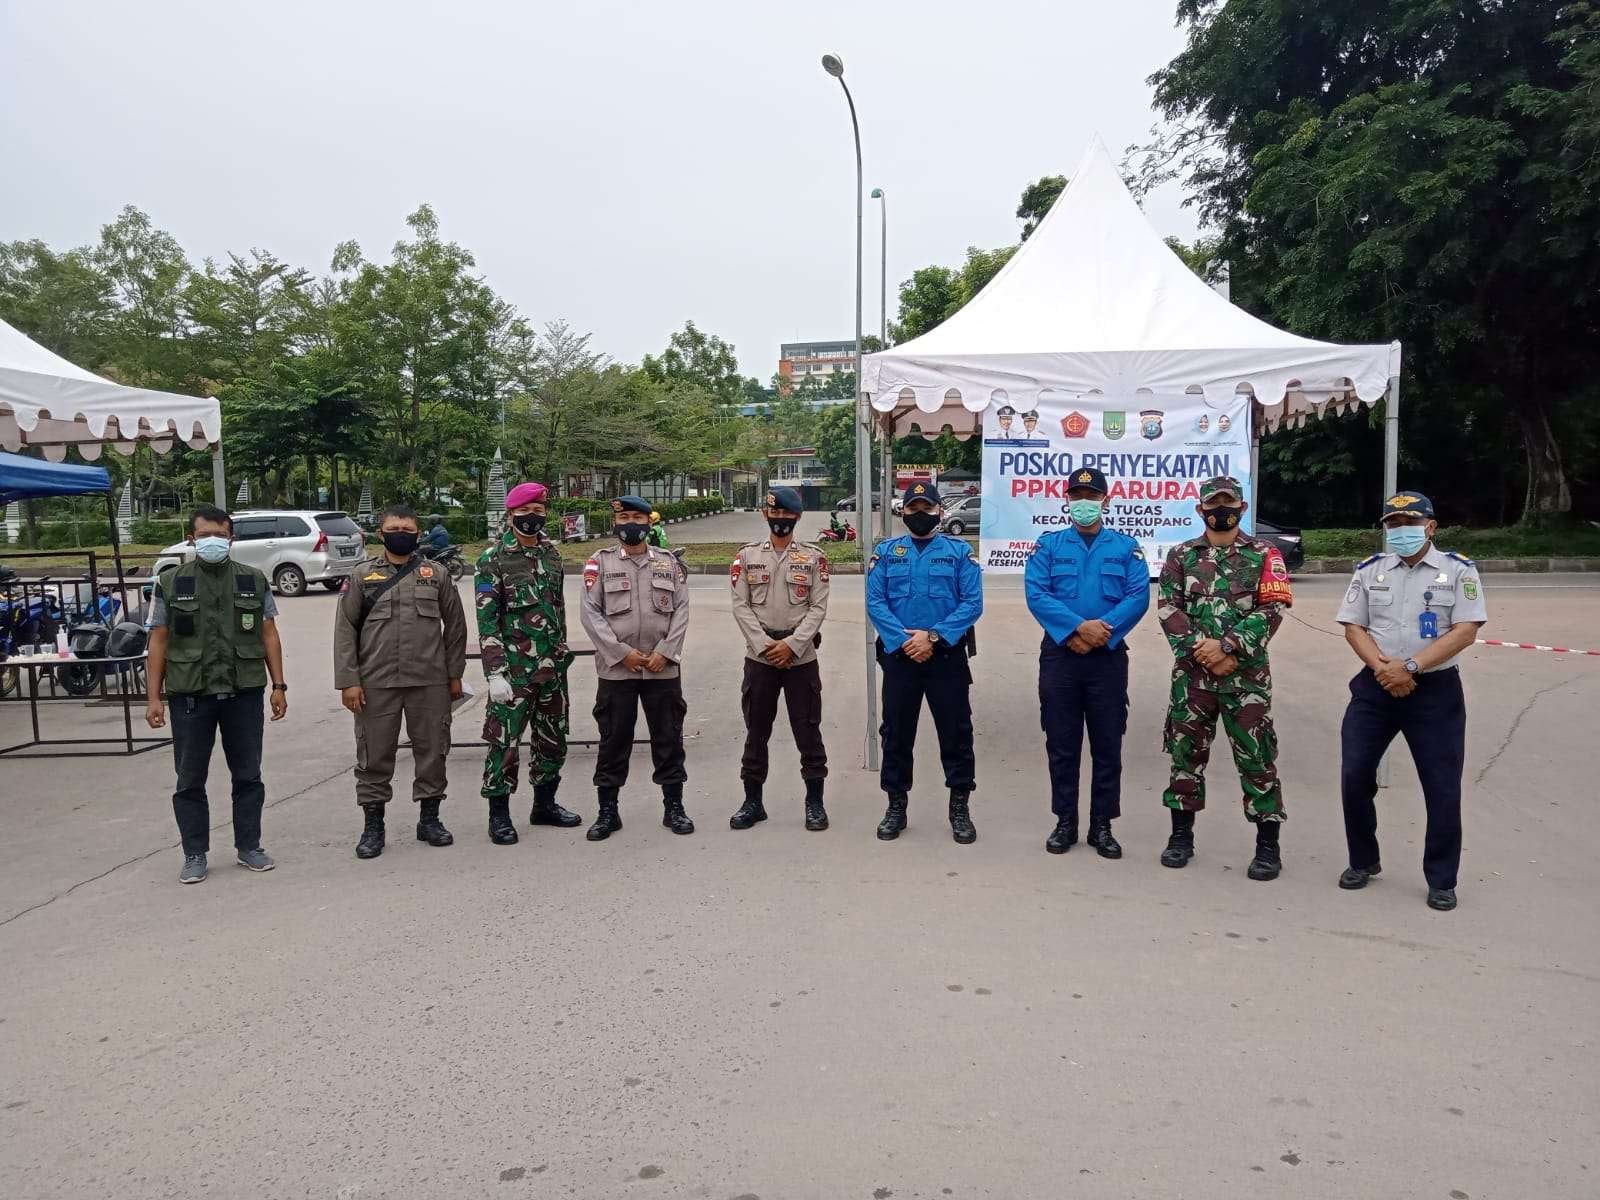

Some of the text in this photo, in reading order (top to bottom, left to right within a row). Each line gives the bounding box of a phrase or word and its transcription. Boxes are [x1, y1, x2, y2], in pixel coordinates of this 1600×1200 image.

[1000, 453, 1229, 478] POSKO PENYEKATAN
[1109, 480, 1206, 501] ARURA
[1115, 504, 1162, 516] TUGAS
[1119, 516, 1192, 527] SEKUPANG
[1116, 528, 1155, 538] ATAM
[990, 550, 1032, 560] PROTOK
